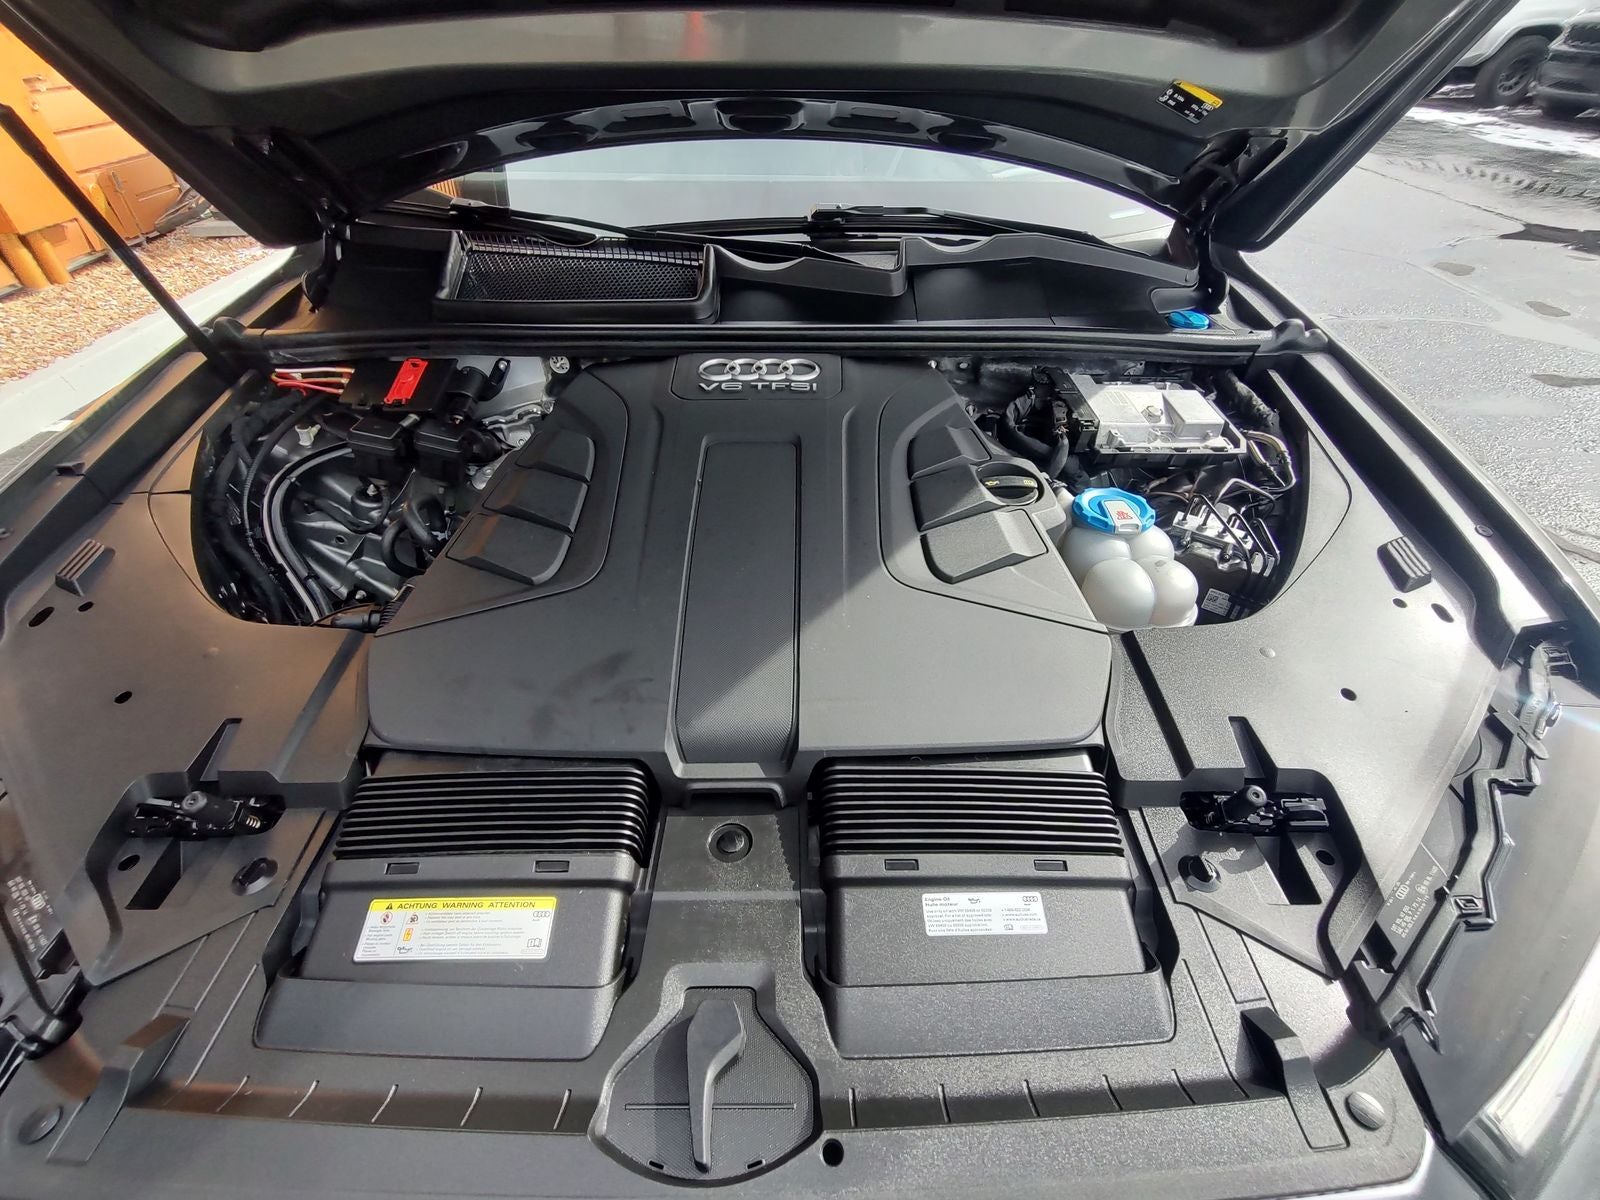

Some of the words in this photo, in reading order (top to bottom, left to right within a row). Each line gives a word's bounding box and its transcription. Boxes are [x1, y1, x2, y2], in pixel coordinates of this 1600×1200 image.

[698, 382, 743, 391] V6
[750, 382, 817, 391] TFSI
[397, 902, 438, 910] ACHTUNG
[487, 901, 536, 909] ATTENTION
